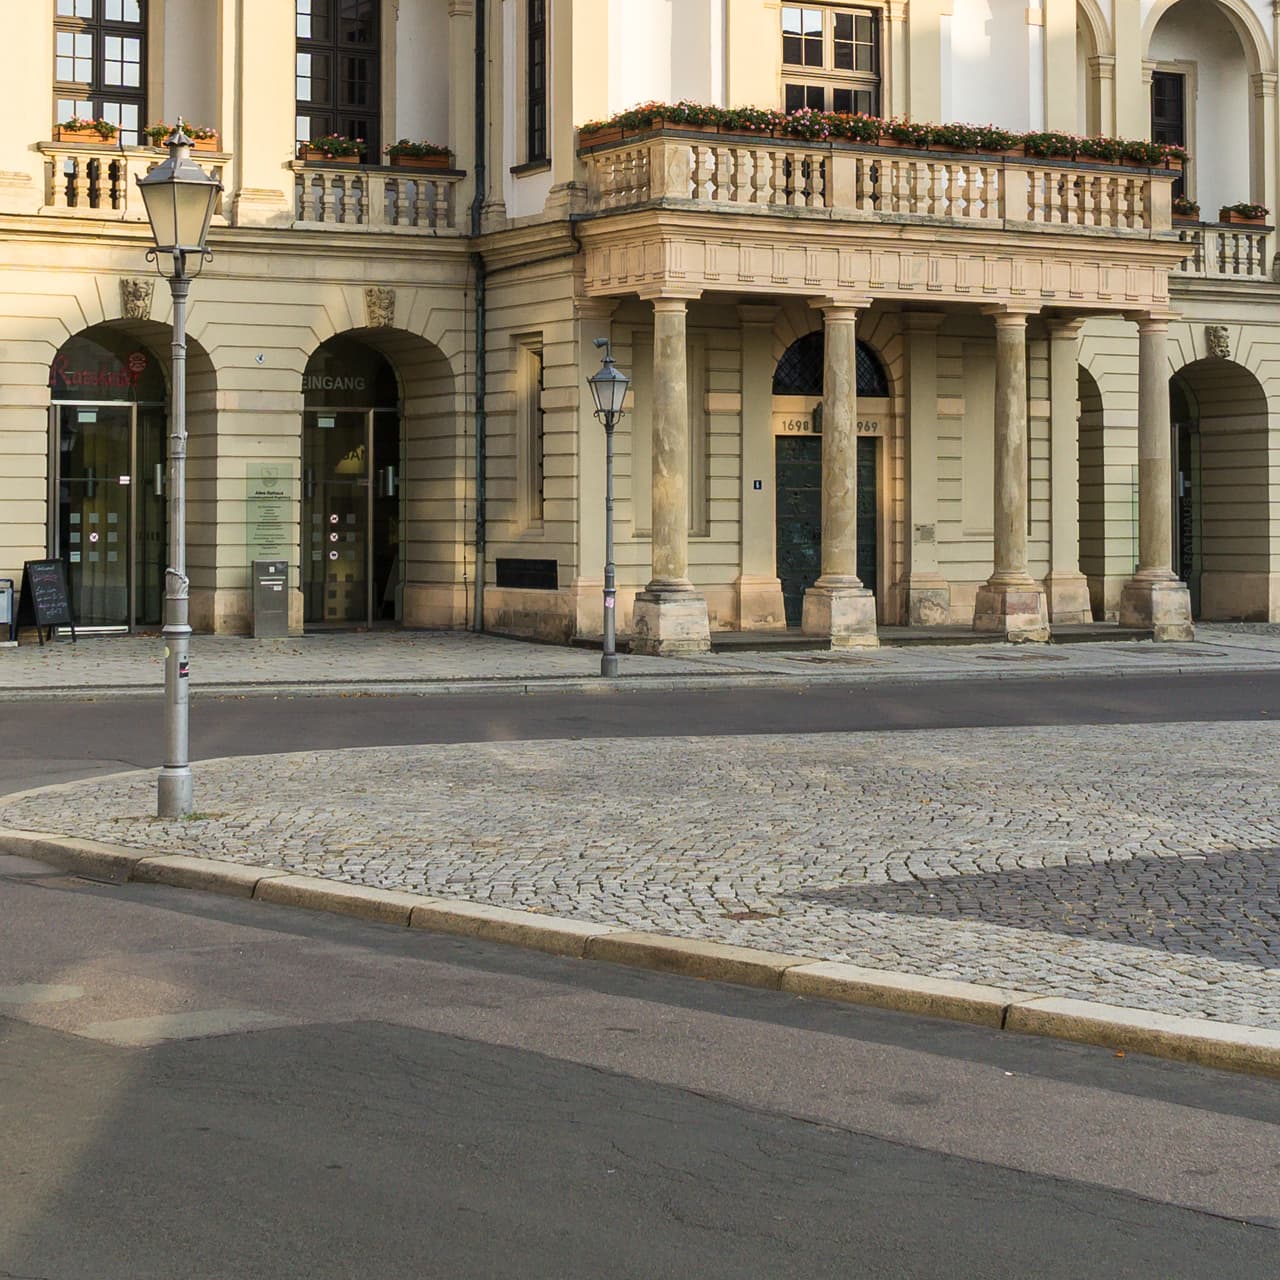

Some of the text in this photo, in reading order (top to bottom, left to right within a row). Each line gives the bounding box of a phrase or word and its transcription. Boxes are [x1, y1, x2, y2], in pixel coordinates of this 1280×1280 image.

[304, 376, 366, 390] EINGANG
[782, 420, 878, 432] 1698 969
